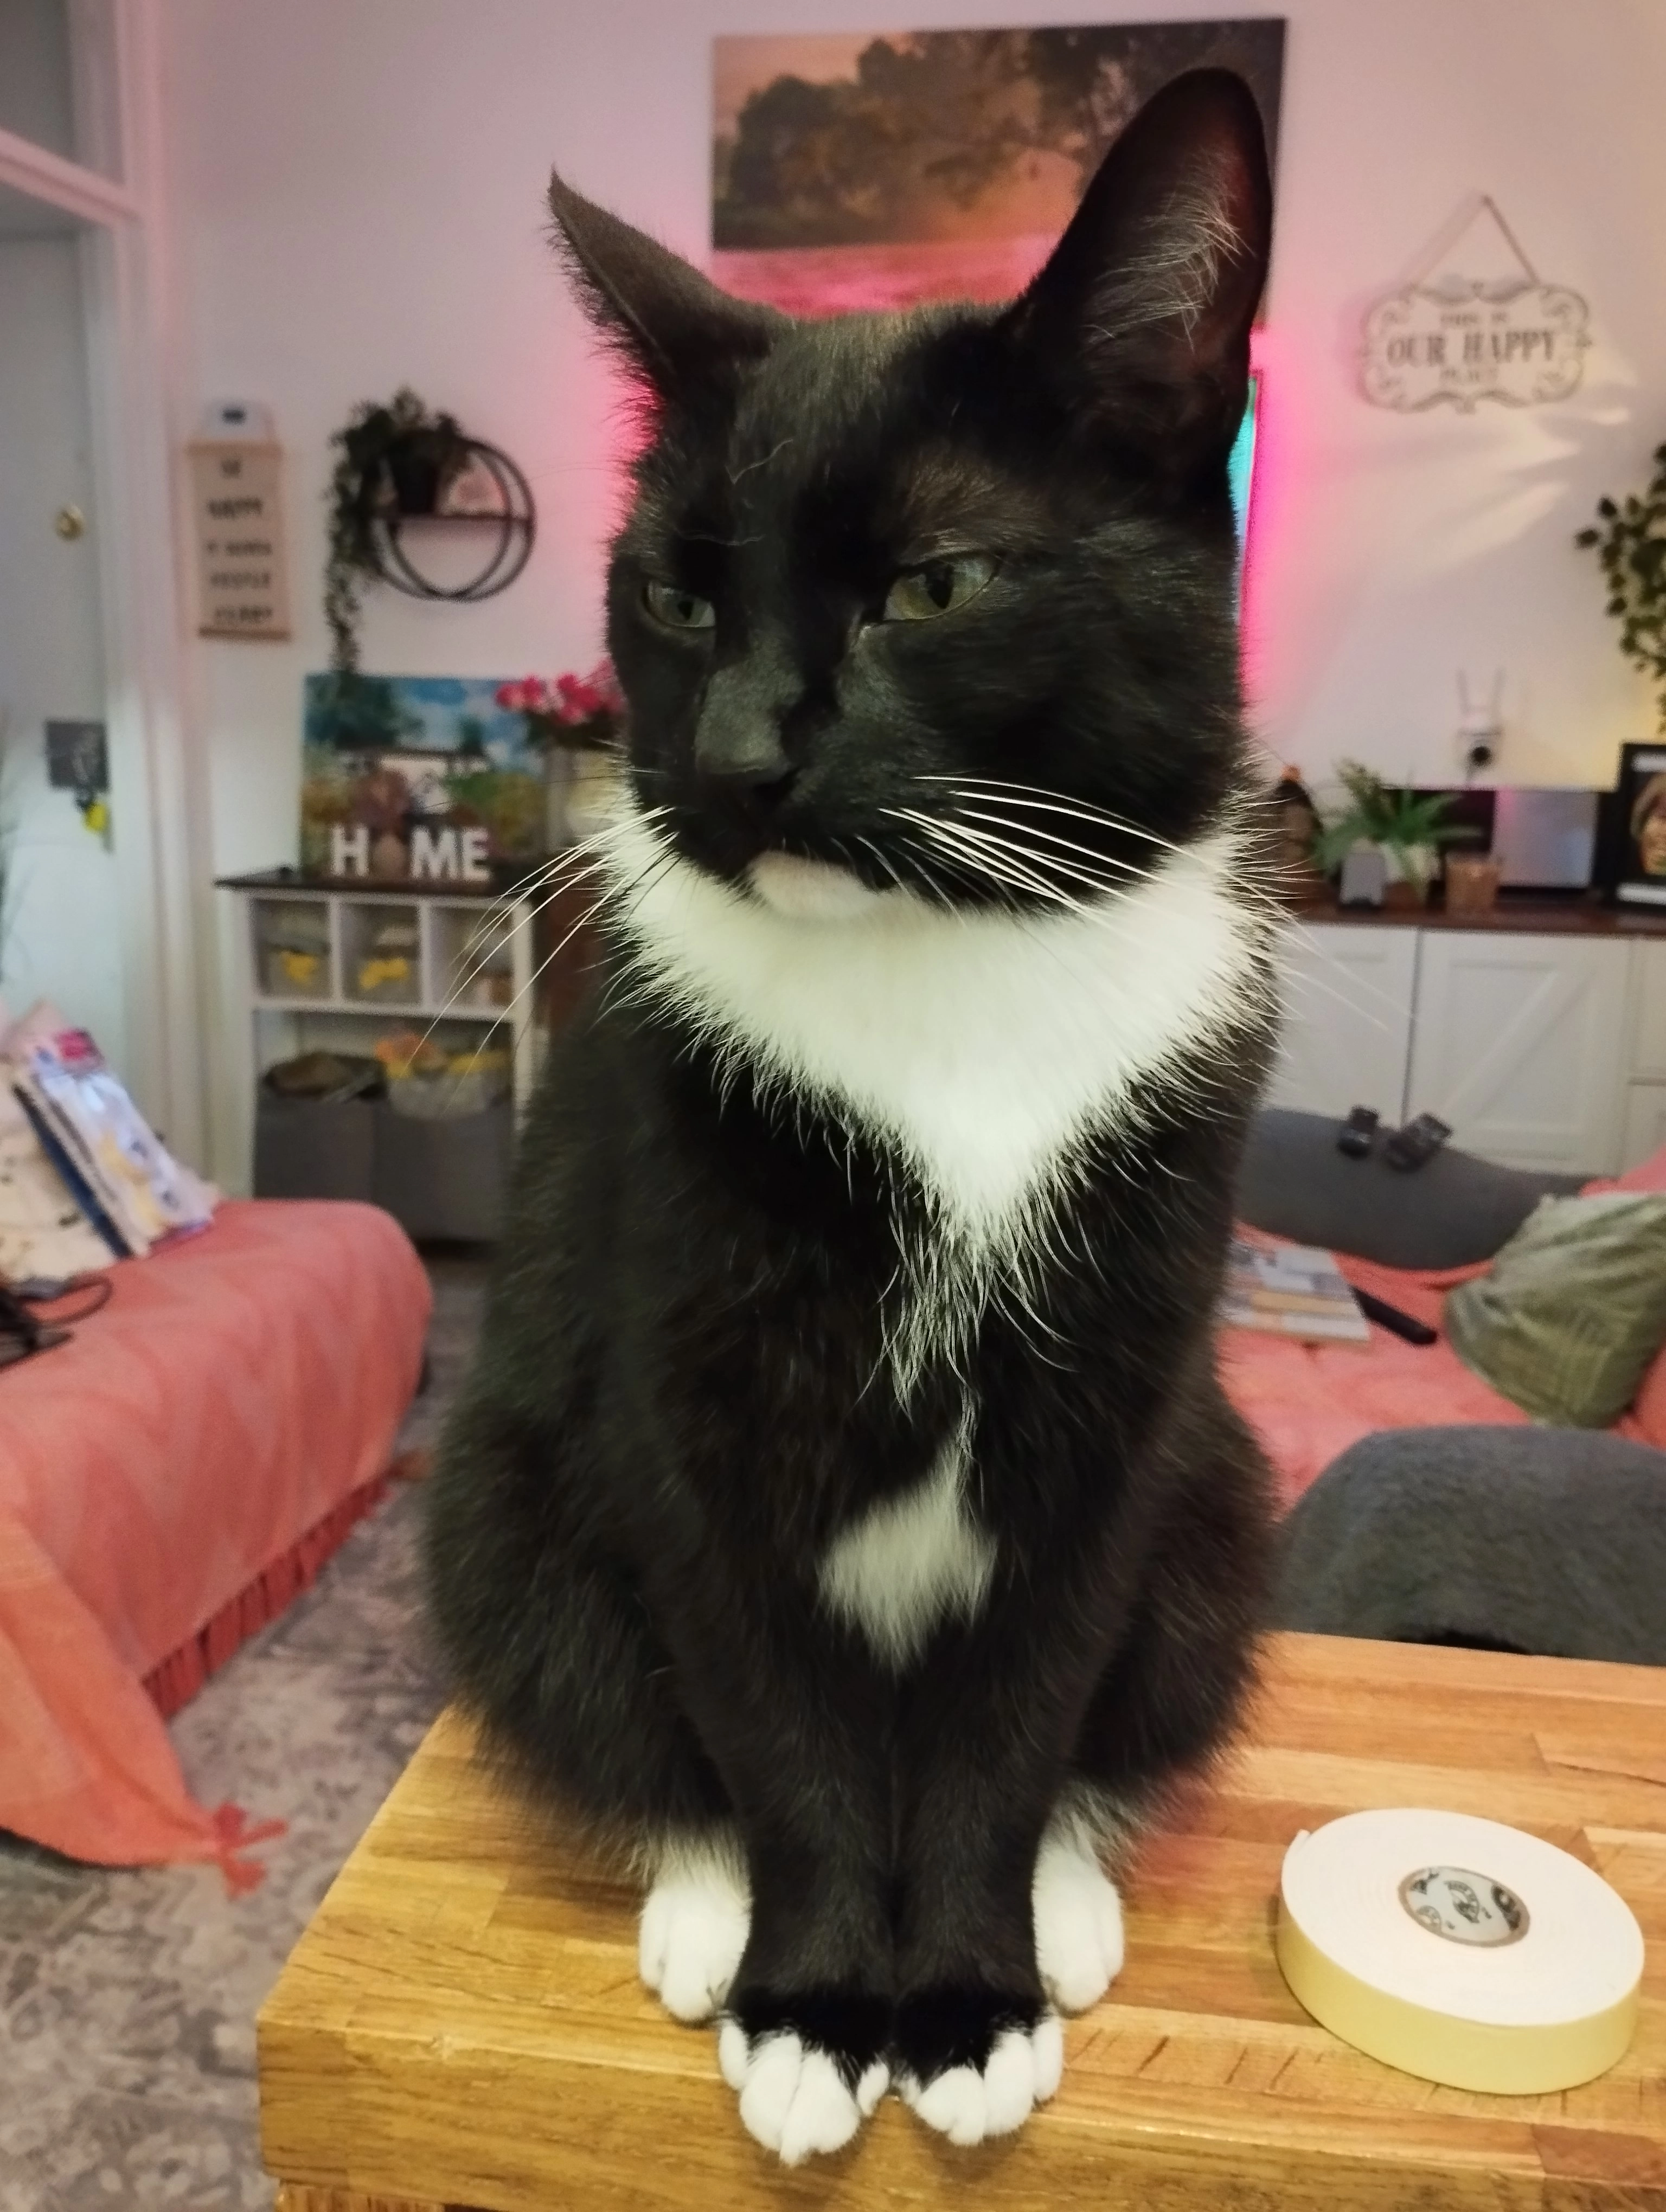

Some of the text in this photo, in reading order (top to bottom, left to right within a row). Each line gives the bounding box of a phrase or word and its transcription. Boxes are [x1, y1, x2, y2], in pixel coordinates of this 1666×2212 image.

[1387, 329, 1554, 367] OUR HAPPY
[330, 823, 490, 882] HME
